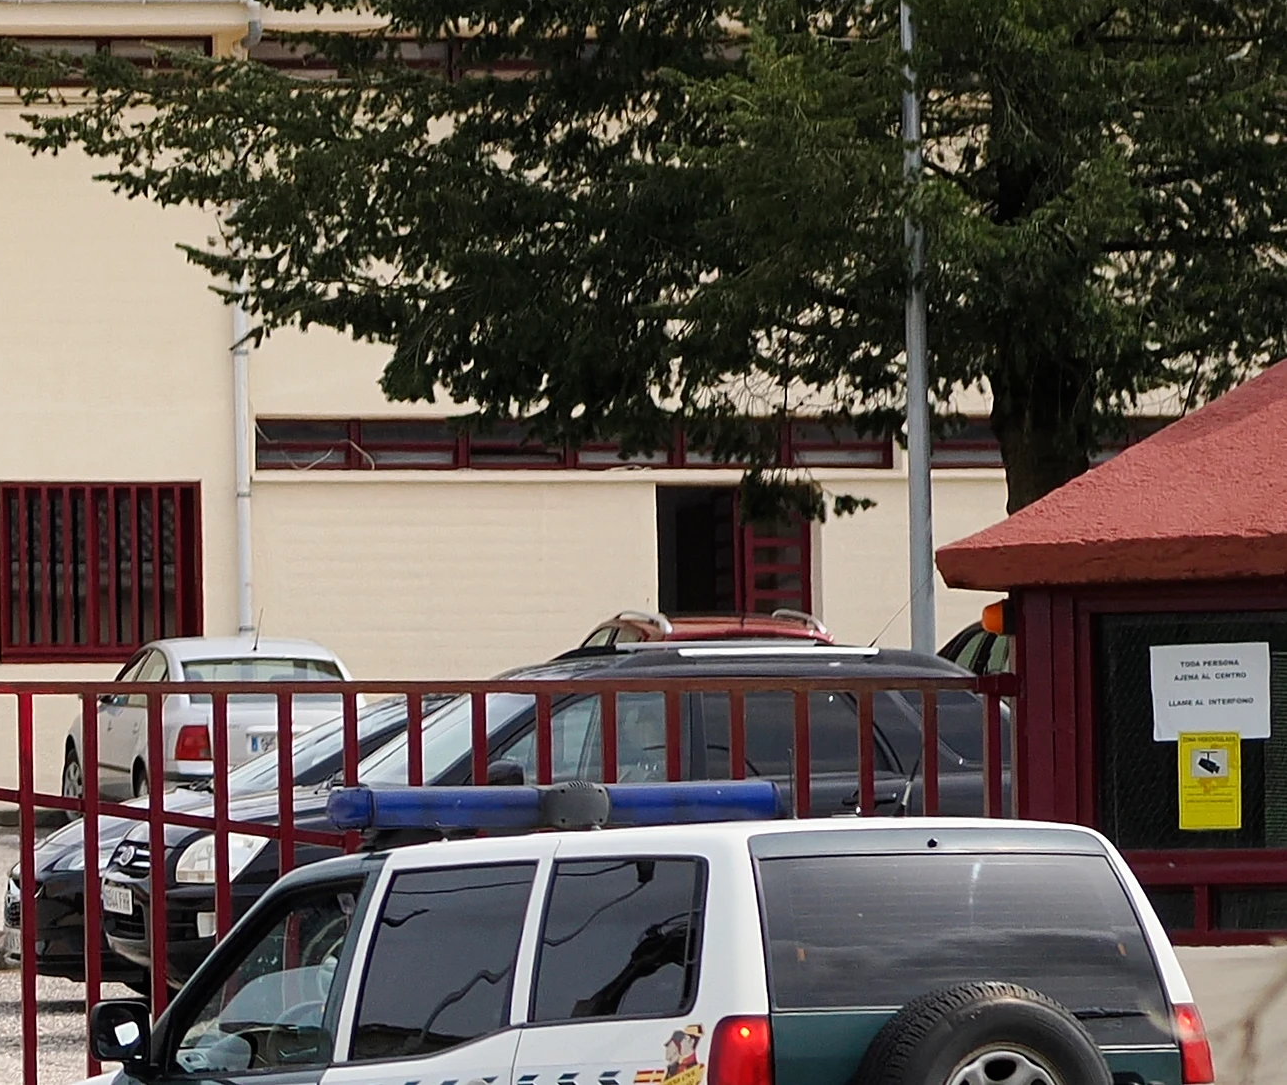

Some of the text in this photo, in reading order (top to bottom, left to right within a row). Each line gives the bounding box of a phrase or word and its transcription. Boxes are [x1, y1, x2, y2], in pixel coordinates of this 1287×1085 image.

[1180, 659, 1239, 668] TODA PERSONA
[1173, 674, 1199, 682] AJENA
[1215, 672, 1247, 680] CENTRO
[1168, 699, 1193, 707] LLAME
[1208, 697, 1254, 706] INTERFONO
